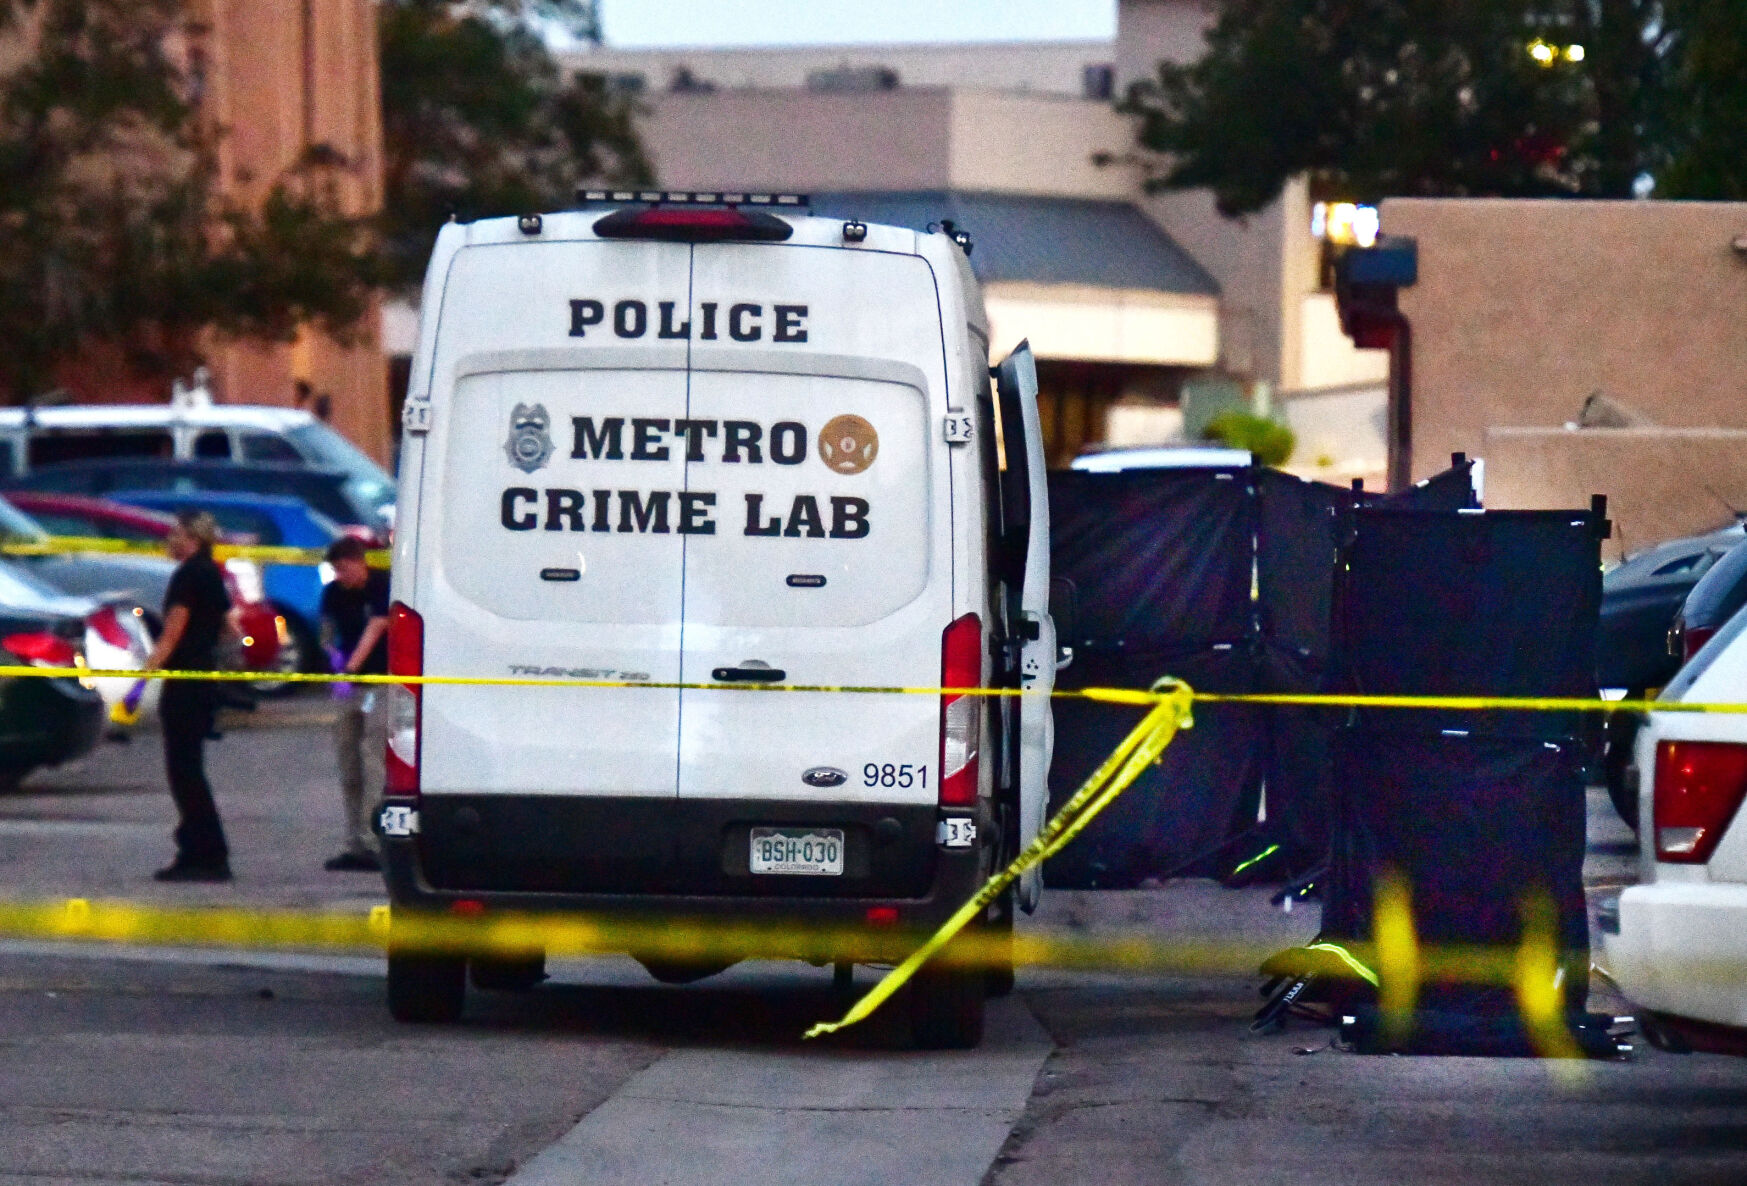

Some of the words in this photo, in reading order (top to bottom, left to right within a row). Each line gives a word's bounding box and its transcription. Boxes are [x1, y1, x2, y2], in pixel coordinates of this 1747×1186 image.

[568, 298, 809, 343] POLICE
[570, 416, 808, 466] METRO
[501, 487, 717, 536] CRIME
[744, 493, 871, 540] LAB
[863, 763, 927, 788] 9851
